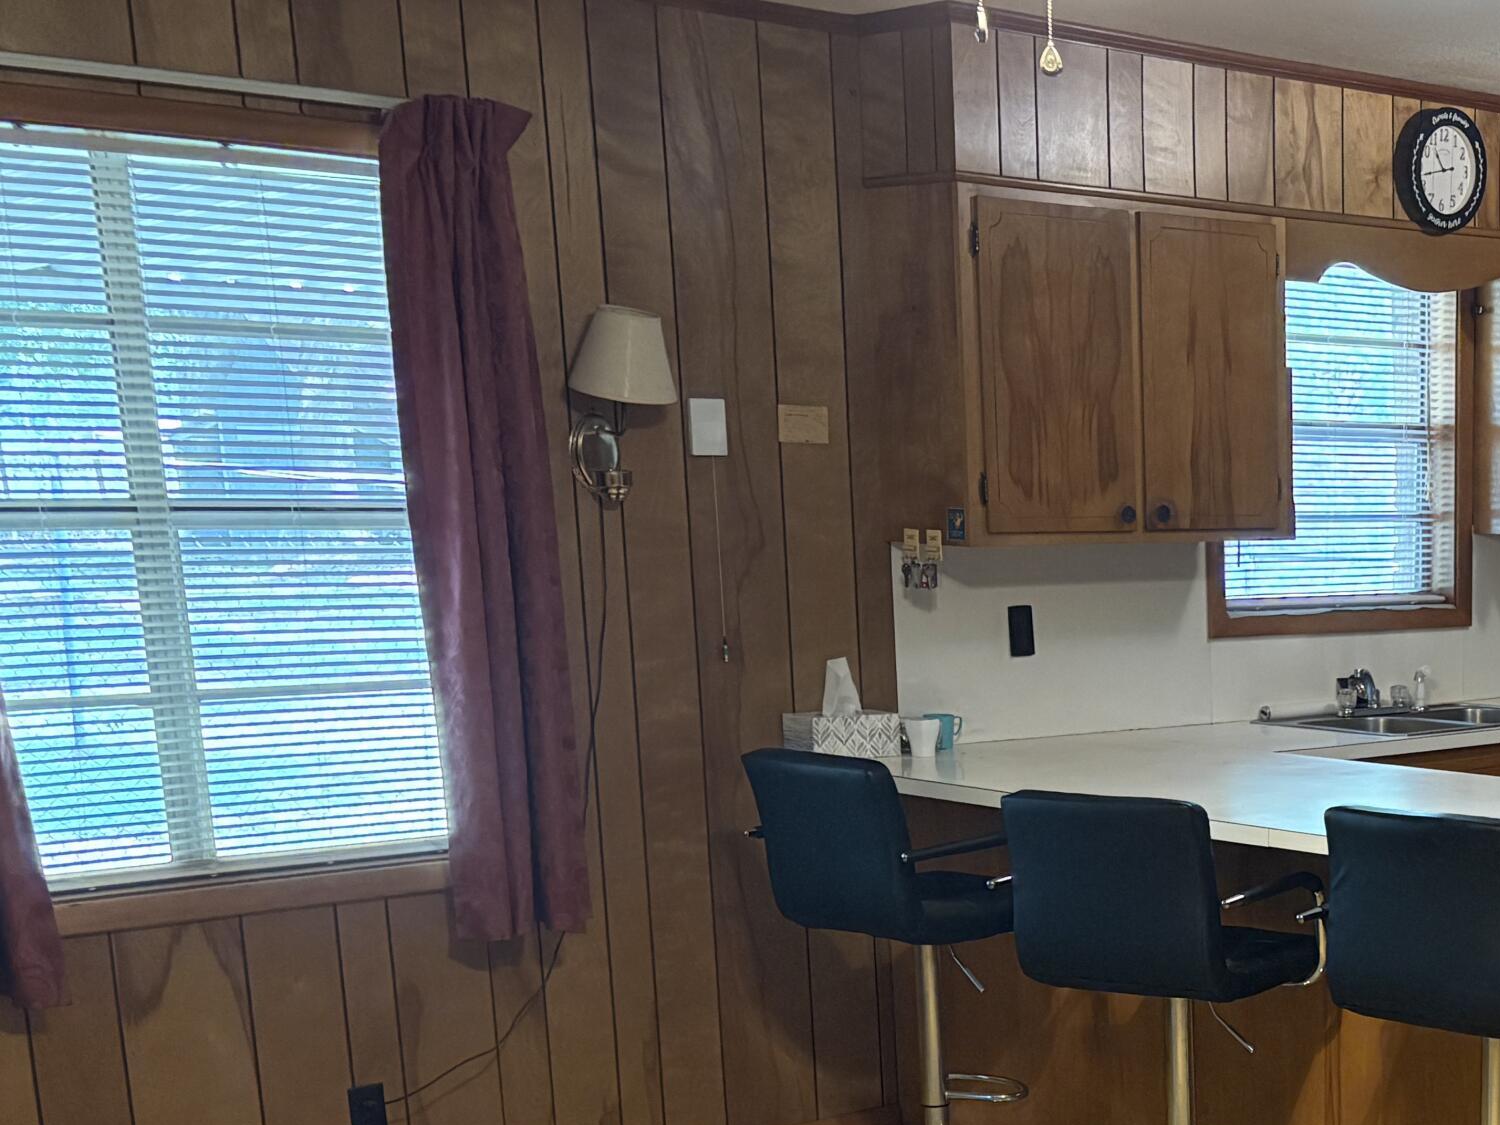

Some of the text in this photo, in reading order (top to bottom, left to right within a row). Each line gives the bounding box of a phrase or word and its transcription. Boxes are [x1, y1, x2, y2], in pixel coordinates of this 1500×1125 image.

[1429, 132, 1438, 146] 11
[1440, 128, 1449, 142] 12
[1453, 134, 1458, 148] 1
[1459, 146, 1466, 161] 2
[1463, 165, 1469, 180] 3
[1457, 182, 1464, 196] 4
[1427, 192, 1435, 204] 7
[1438, 198, 1445, 212] 6
[1449, 194, 1457, 208] 5
